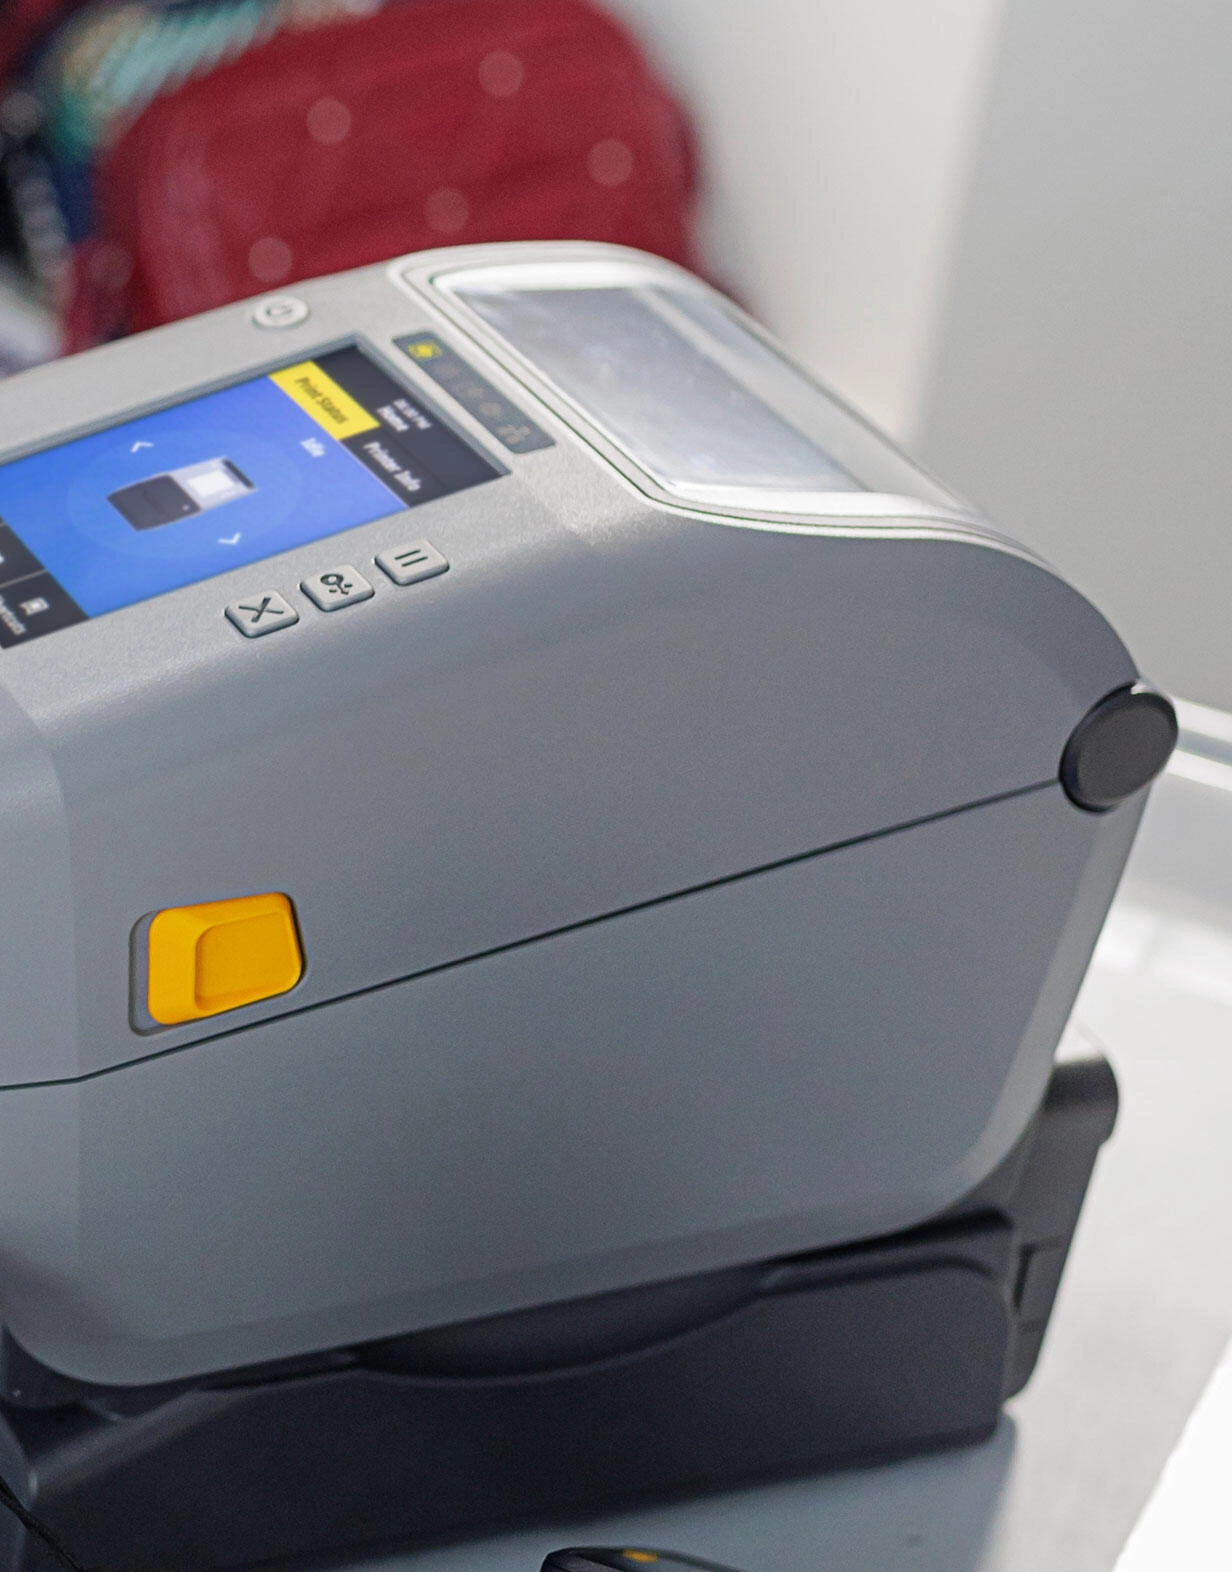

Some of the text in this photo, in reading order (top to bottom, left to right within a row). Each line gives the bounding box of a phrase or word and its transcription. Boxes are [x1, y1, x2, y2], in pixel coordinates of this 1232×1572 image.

[293, 376, 350, 424] Print Status
[363, 441, 401, 473] Printer
